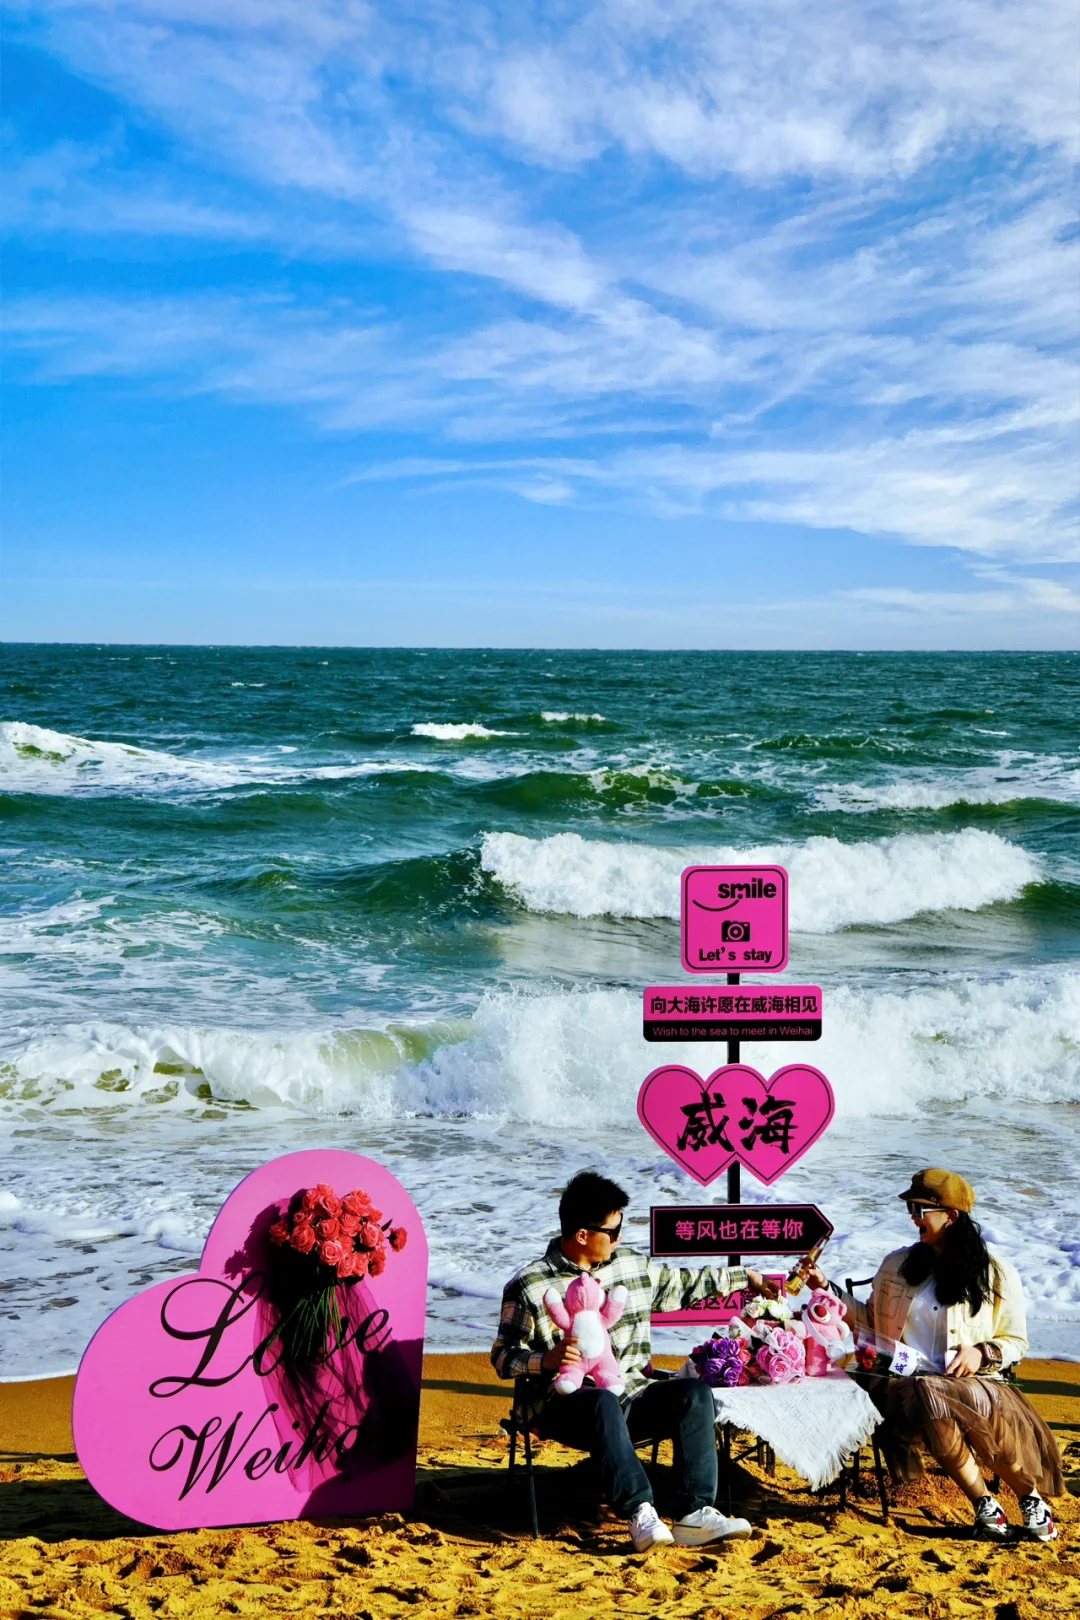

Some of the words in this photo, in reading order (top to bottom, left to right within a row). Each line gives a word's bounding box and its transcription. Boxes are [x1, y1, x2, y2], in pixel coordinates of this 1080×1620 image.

[718, 877, 777, 899] smile
[743, 949, 772, 963] stay
[651, 996, 818, 1014] 向大海许愿在威海相见
[652, 1026, 678, 1036] Wish
[679, 1026, 689, 1036] to
[691, 1026, 707, 1036] the
[709, 1027, 728, 1036] sea
[729, 1026, 740, 1036] to
[741, 1026, 766, 1036] meet
[768, 1026, 778, 1036] in
[780, 1025, 813, 1036] Weihai
[676, 1091, 800, 1154] 威海
[675, 1219, 803, 1241] 等风也在等你
